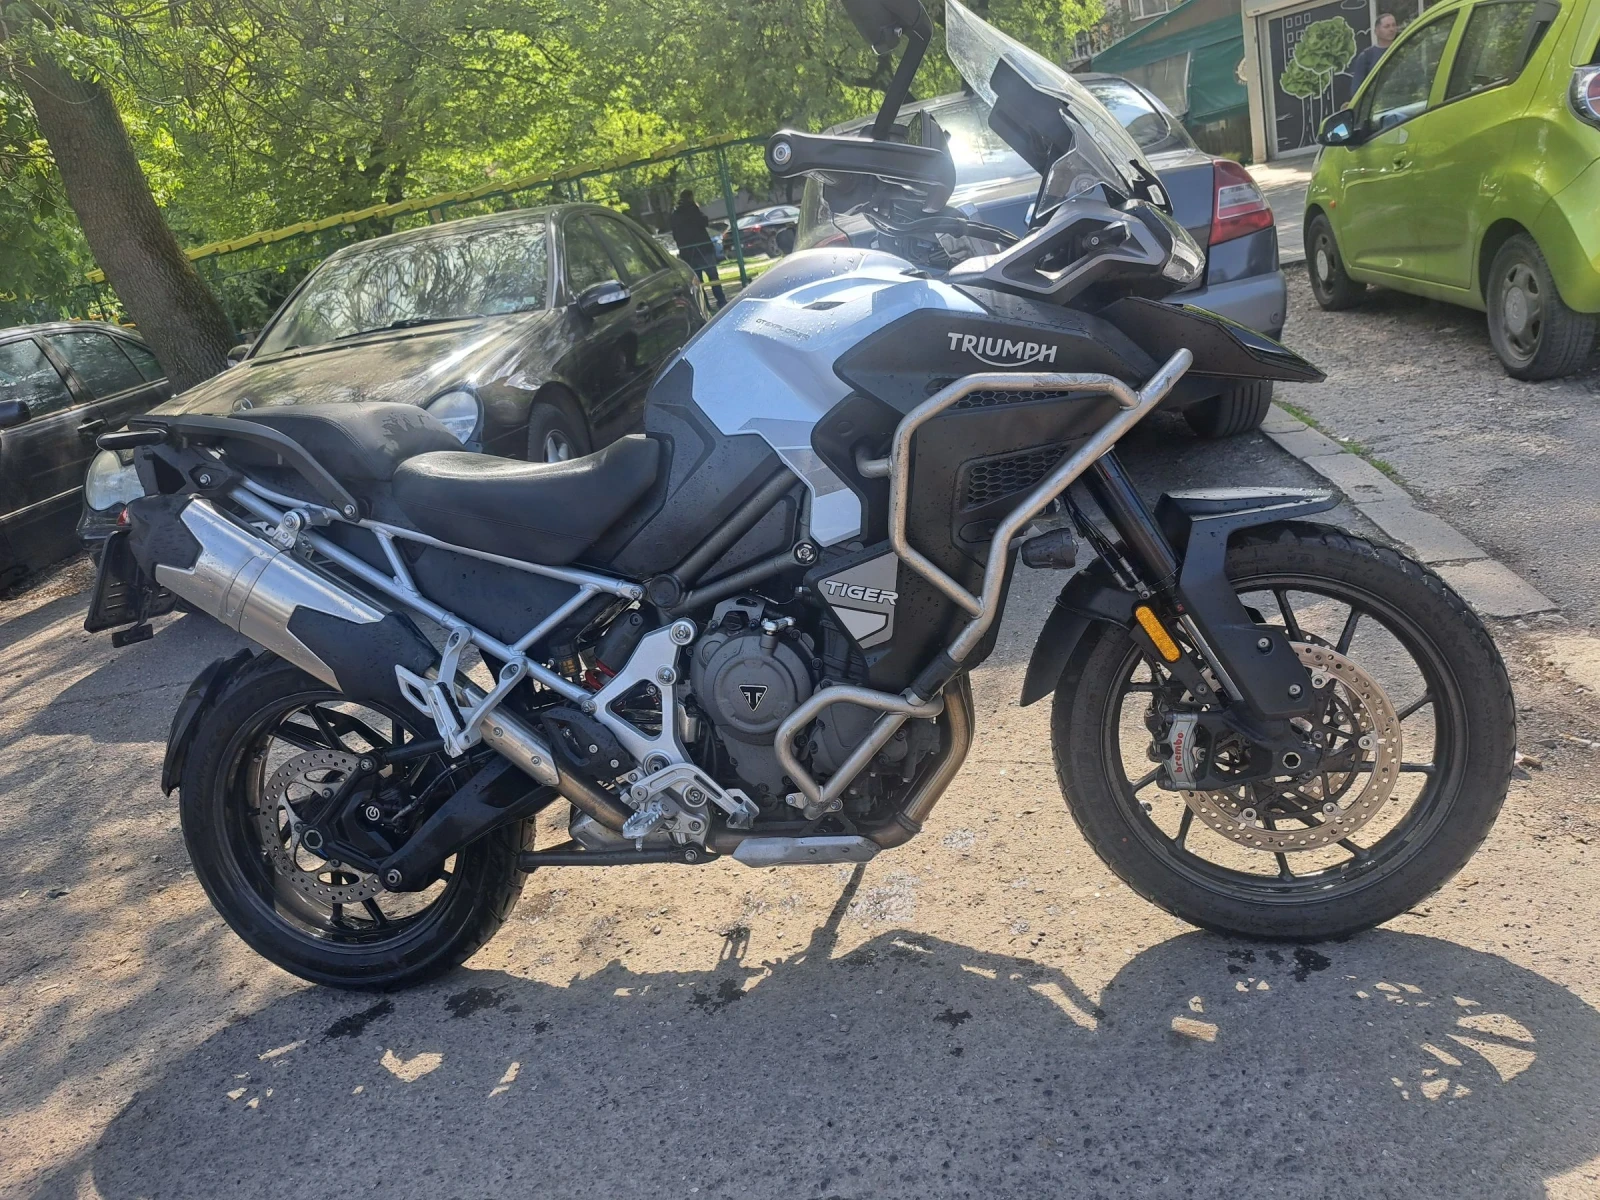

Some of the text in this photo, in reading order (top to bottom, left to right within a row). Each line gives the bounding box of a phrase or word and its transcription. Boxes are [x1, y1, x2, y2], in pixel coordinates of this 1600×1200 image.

[947, 332, 1058, 366] TRIUMPH
[825, 580, 899, 605] TIGER
[1173, 732, 1184, 773] brembo
